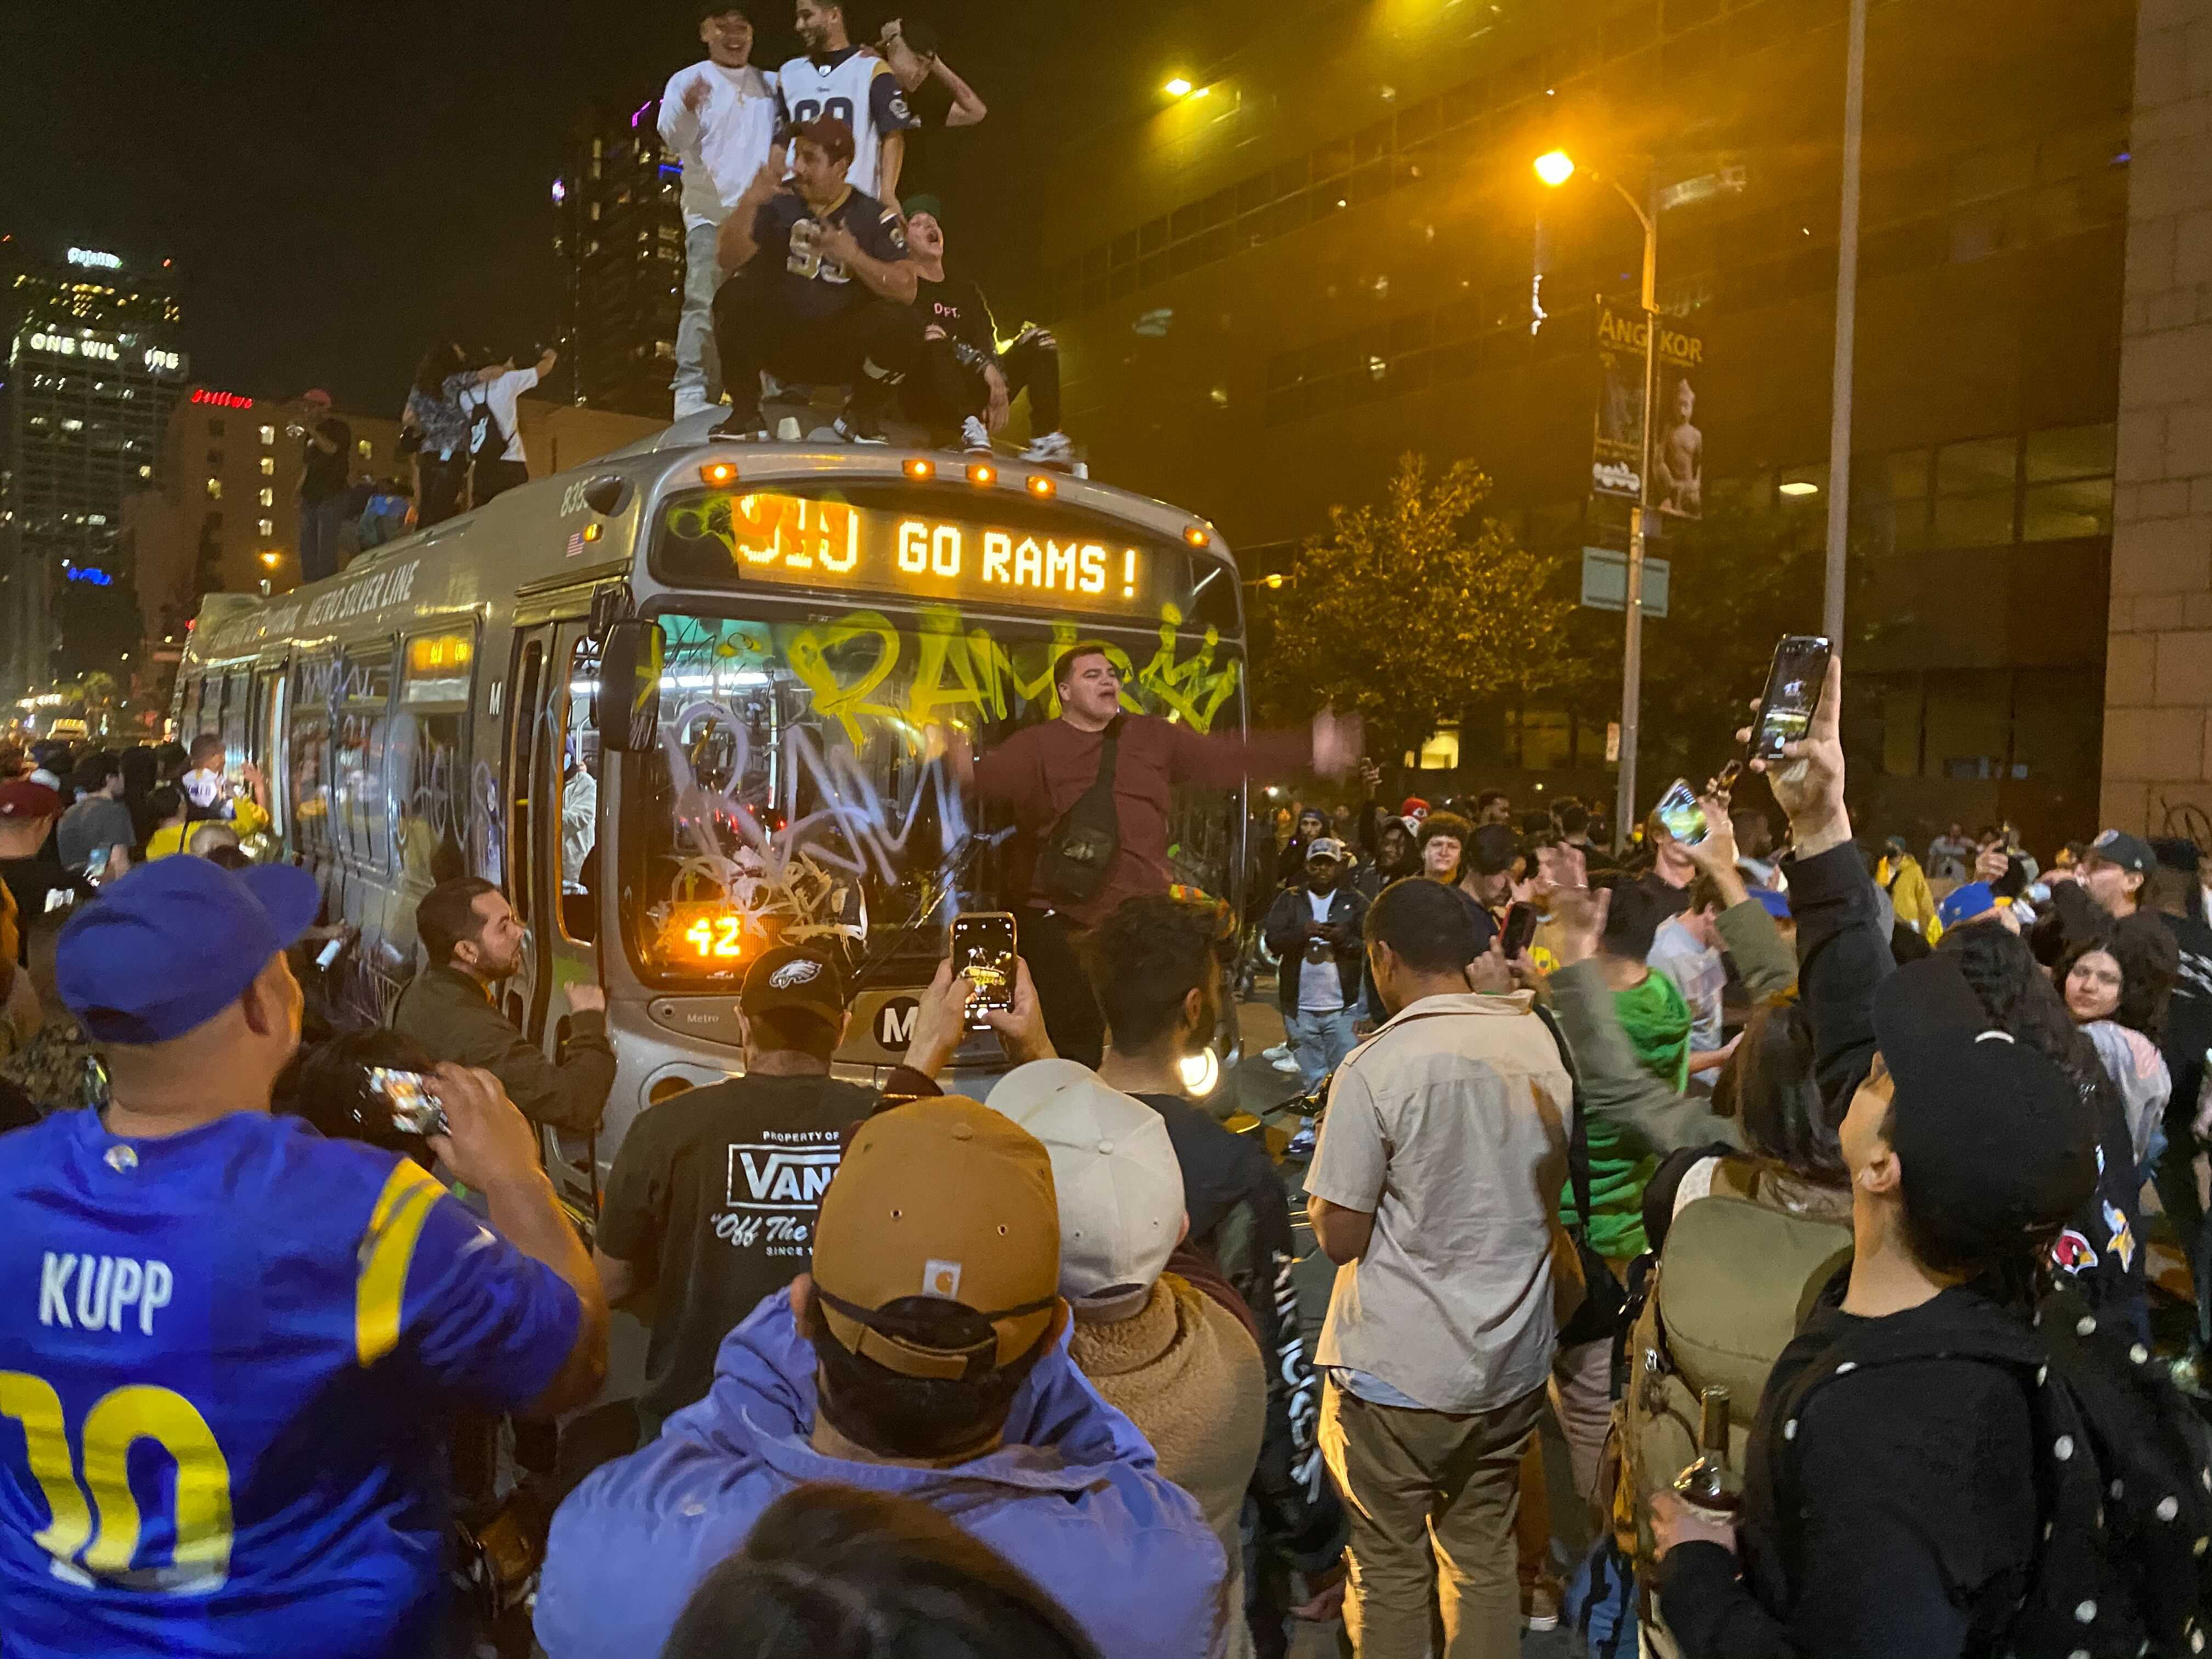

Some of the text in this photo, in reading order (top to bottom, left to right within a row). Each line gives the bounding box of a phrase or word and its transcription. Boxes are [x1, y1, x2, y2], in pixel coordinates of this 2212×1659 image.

[31, 333, 75, 354] ONE
[898, 520, 961, 577] GO
[686, 917, 740, 956] 42
[687, 1013, 719, 1024] Metro
[882, 1006, 919, 1043] M
[763, 1131, 822, 1143] PROPERTY
[739, 1152, 841, 1201] VAN
[766, 1216, 809, 1242] The
[766, 1246, 803, 1256] SINCE
[38, 1251, 173, 1336] KUPP
[0, 1369, 235, 1595] 10
